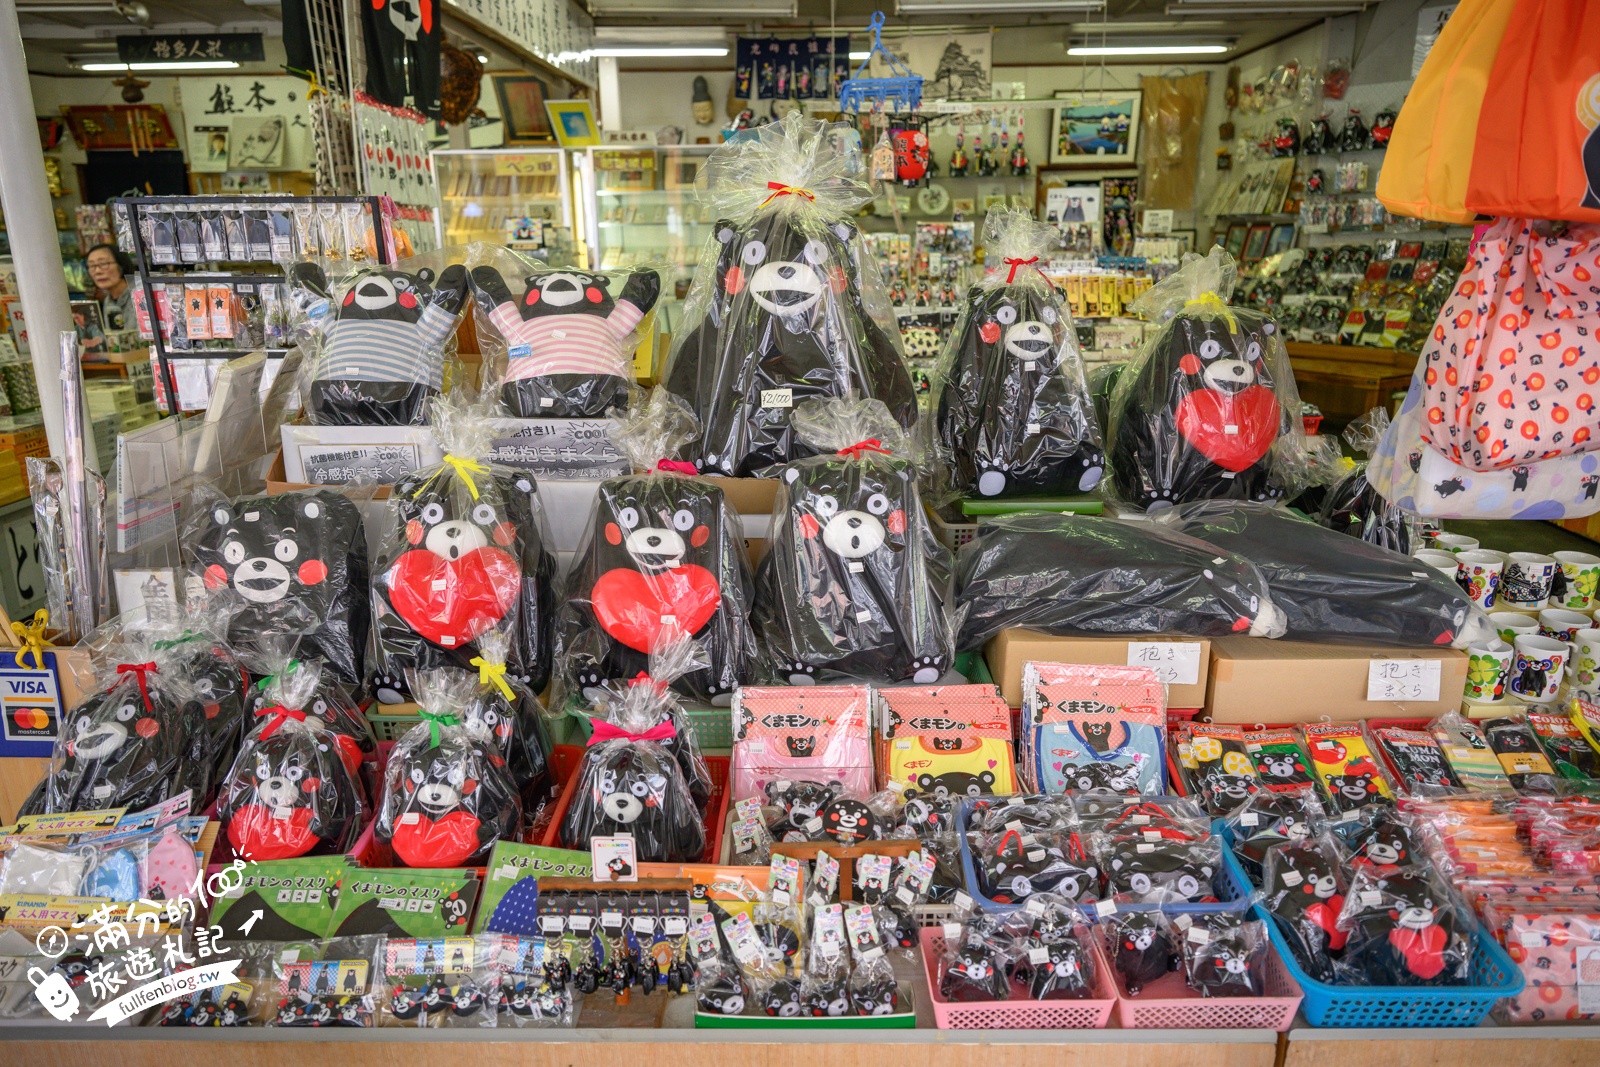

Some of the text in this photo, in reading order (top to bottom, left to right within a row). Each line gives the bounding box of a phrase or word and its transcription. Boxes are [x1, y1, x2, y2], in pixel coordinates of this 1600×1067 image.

[205, 81, 276, 115] 熊本
[7, 680, 47, 694] VISA
[1057, 700, 1115, 713] くまモンの
[761, 714, 820, 728] くまモンの
[909, 718, 965, 730] くまモンの
[18, 728, 50, 736] mastercard
[1535, 724, 1577, 732] soks
[1399, 746, 1440, 755] KUMA
[1411, 753, 1440, 763] MON
[904, 760, 932, 769] くまモン
[235, 876, 326, 889] まモンのマスク
